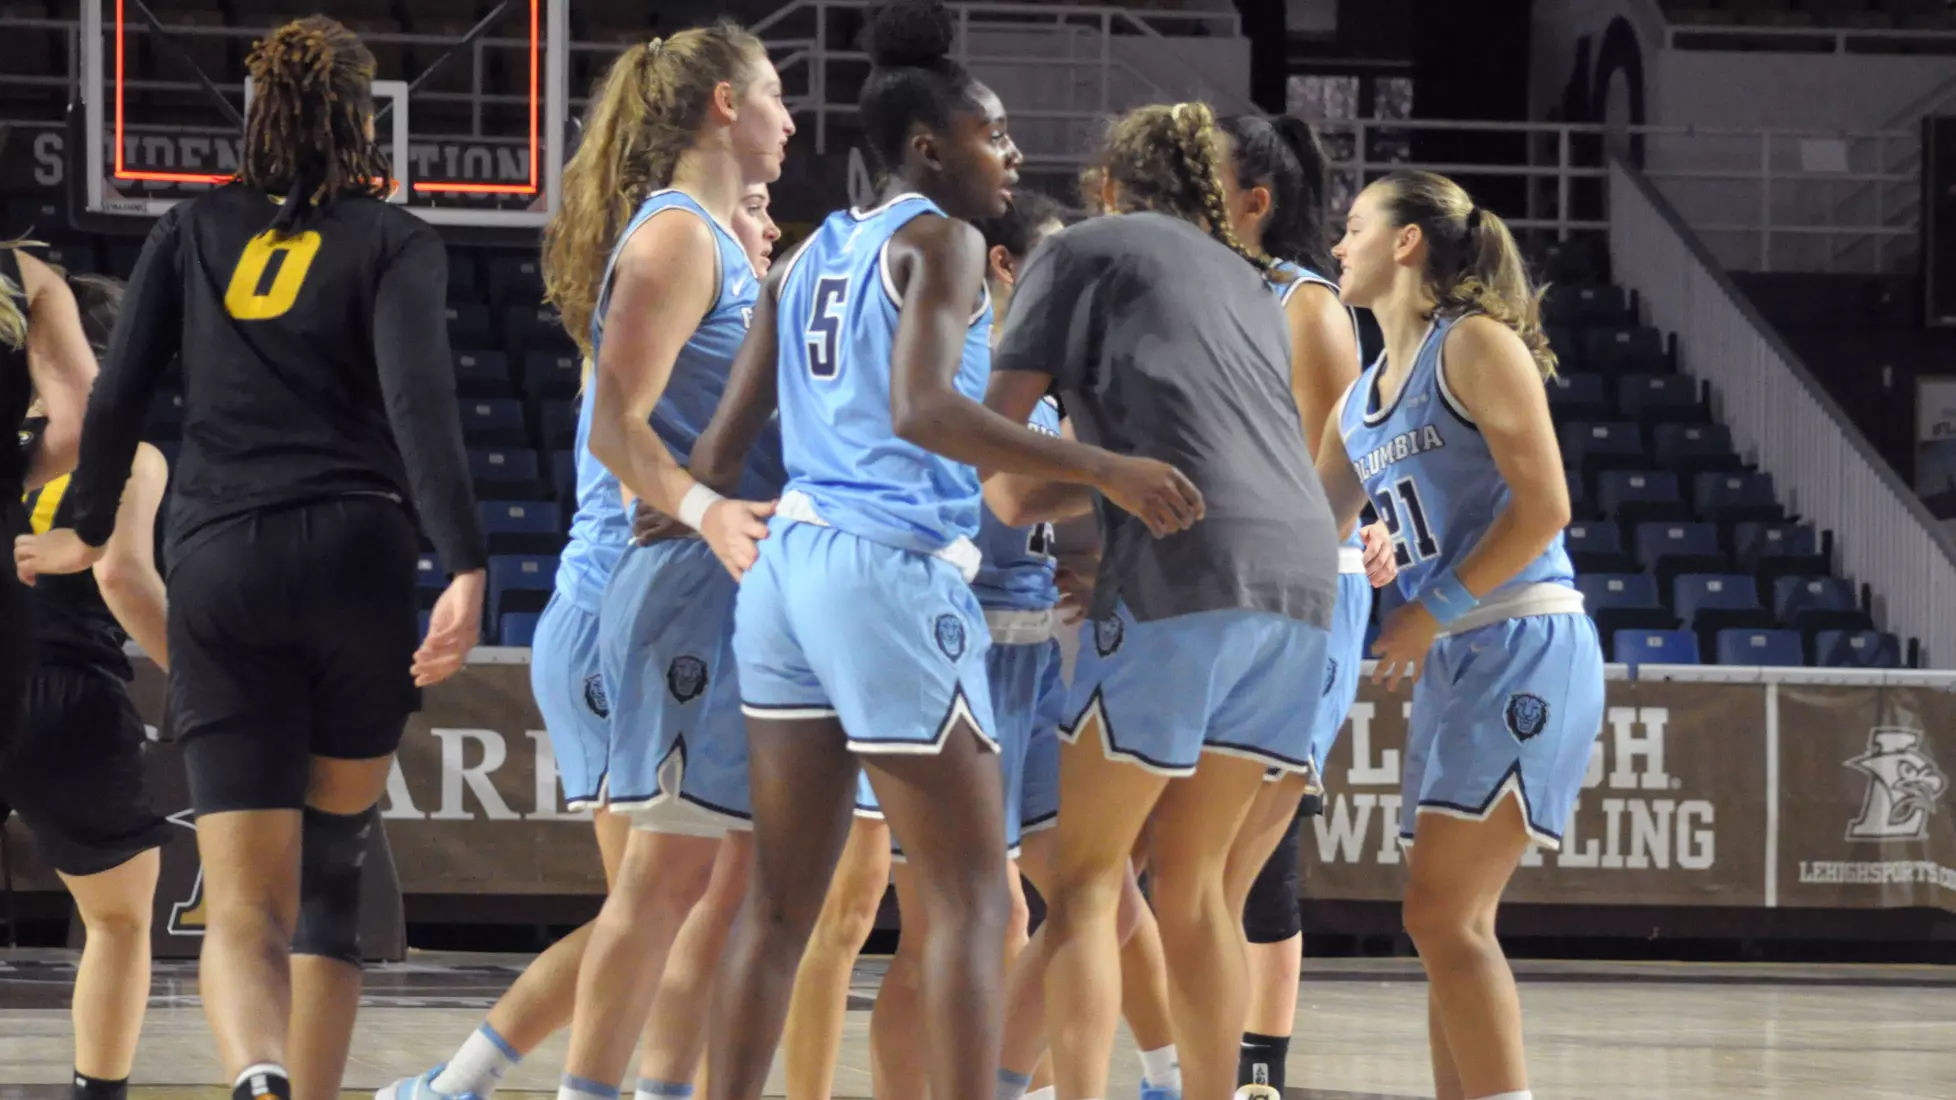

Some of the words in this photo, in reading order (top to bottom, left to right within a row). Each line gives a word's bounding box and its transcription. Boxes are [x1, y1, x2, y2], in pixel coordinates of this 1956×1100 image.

[224, 228, 322, 320] 0
[805, 275, 848, 380] 5
[1353, 424, 1445, 484] LUMBIA
